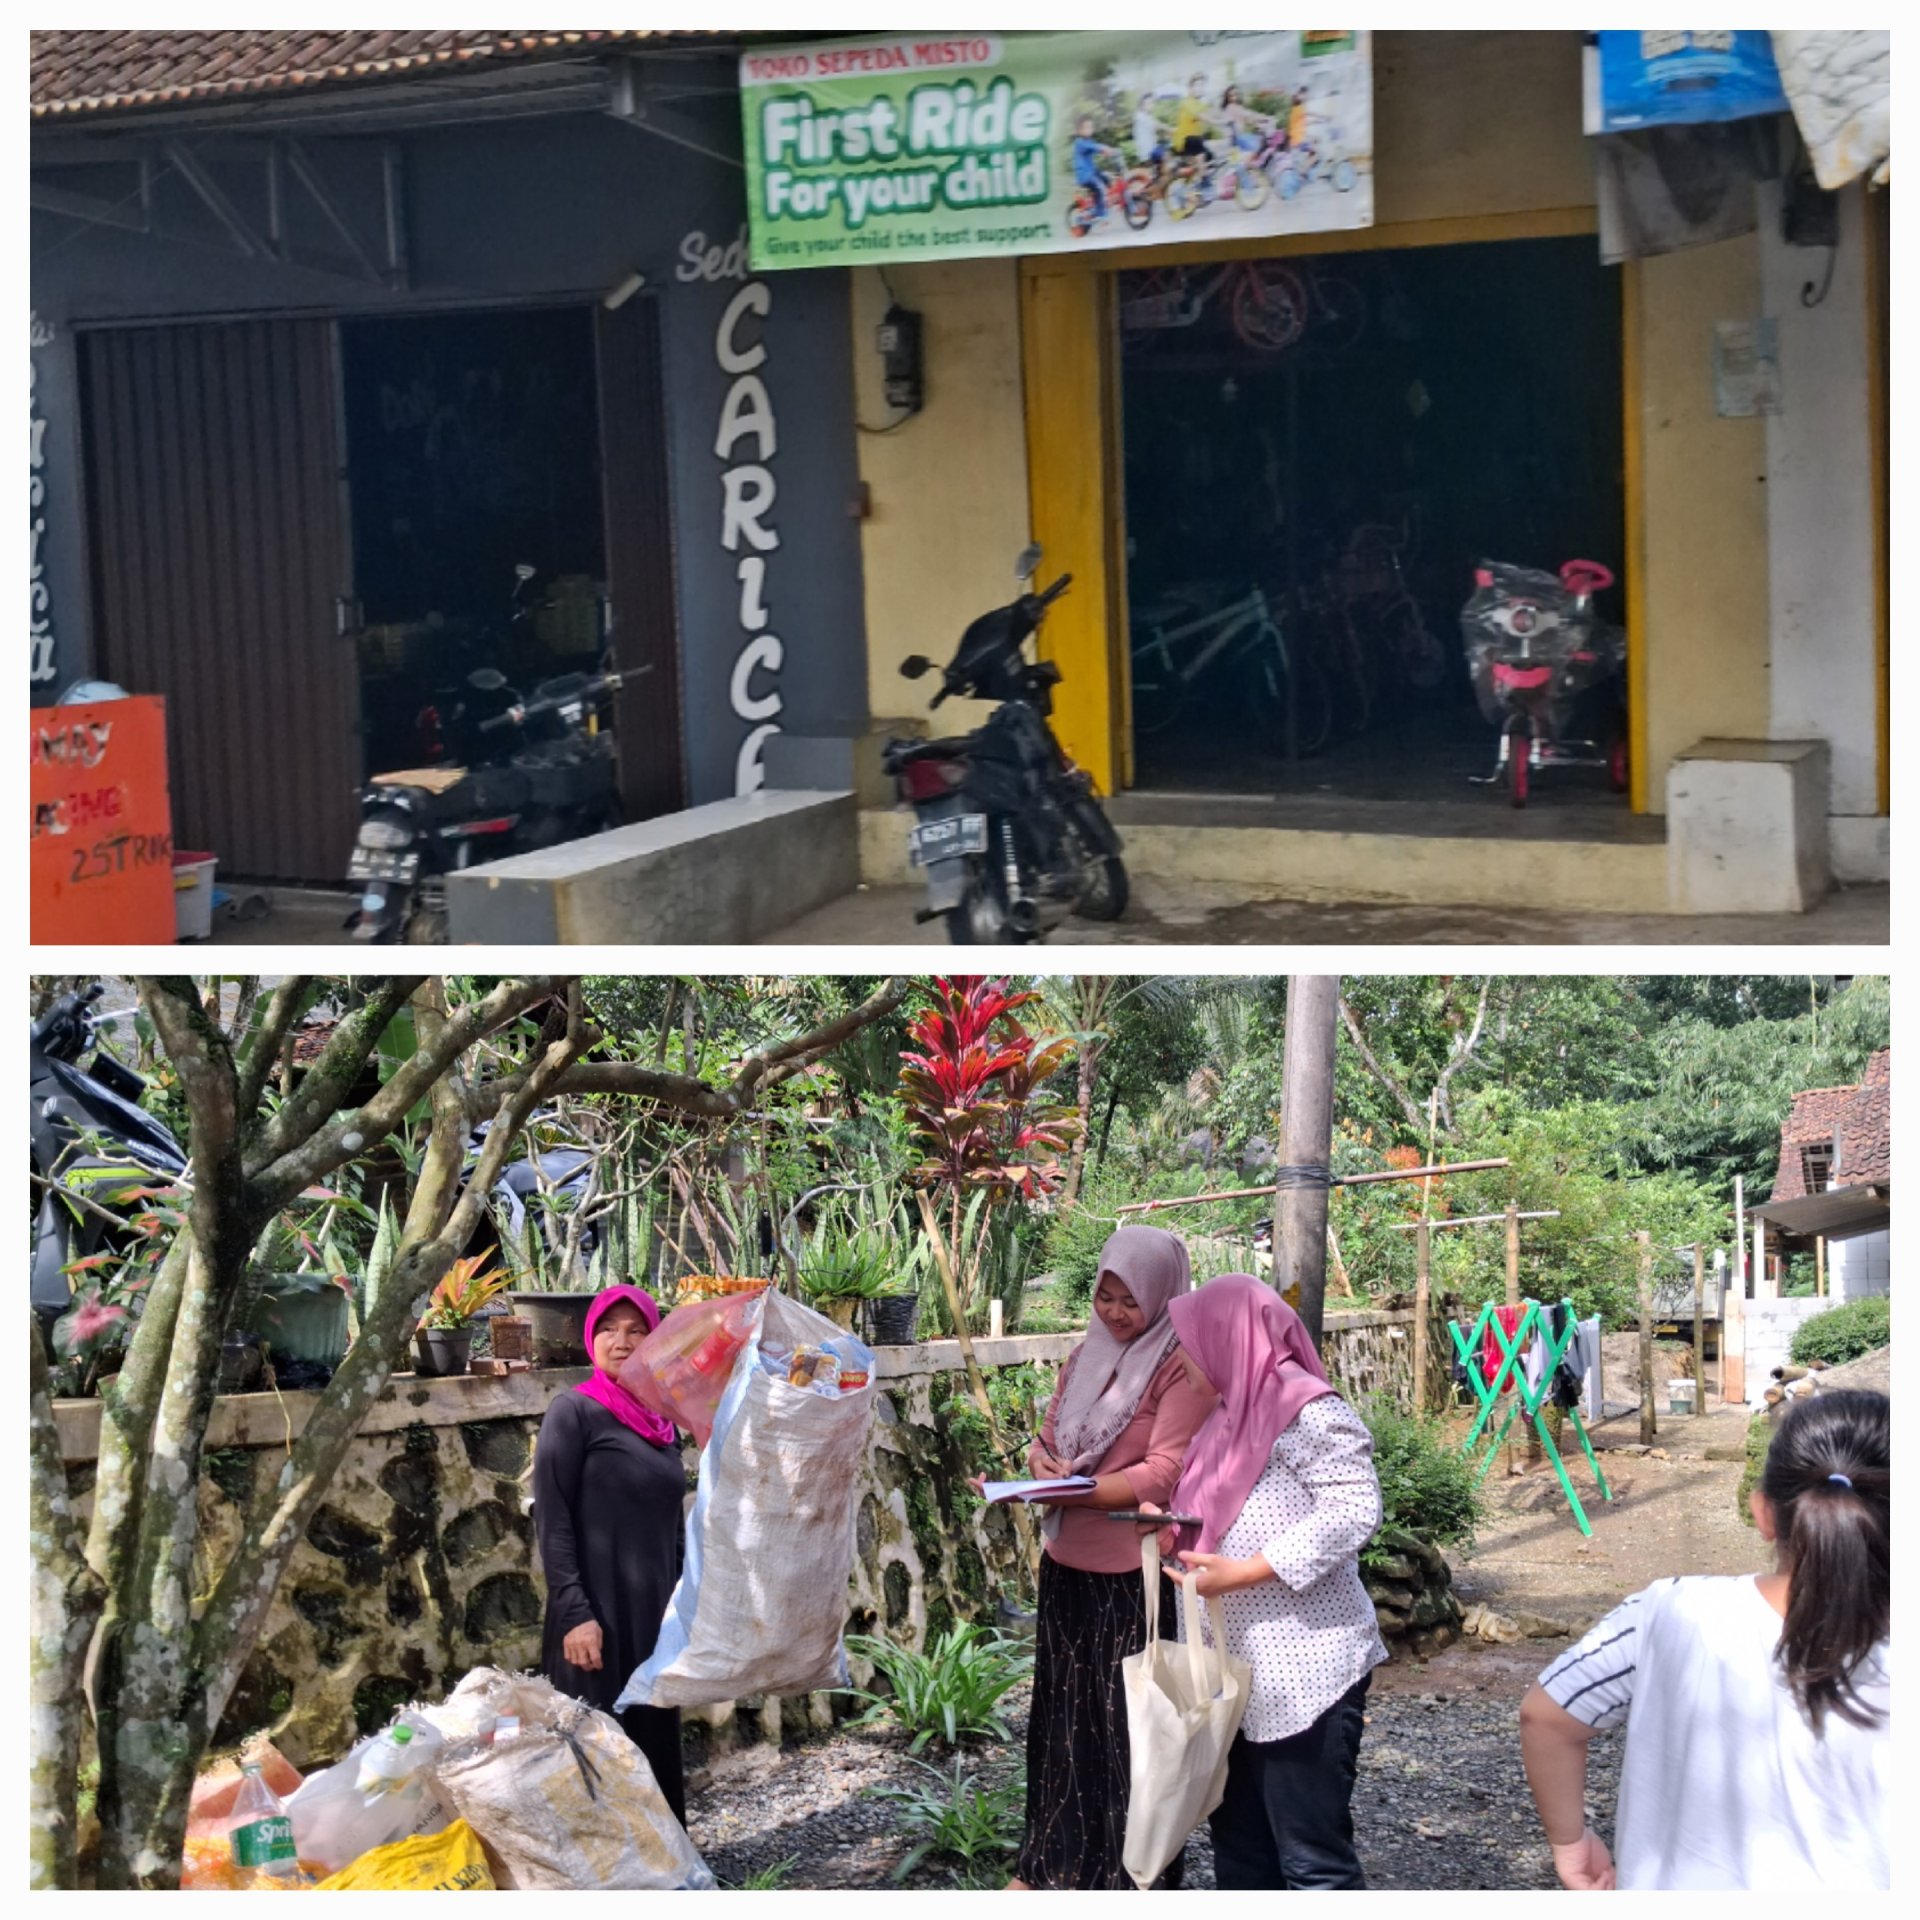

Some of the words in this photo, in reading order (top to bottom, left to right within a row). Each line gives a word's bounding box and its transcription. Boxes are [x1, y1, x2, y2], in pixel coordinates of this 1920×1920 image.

[750, 56, 809, 79] TOKO
[815, 46, 908, 76] SEPEDA
[913, 38, 991, 66] MISTO
[763, 96, 896, 163] First
[910, 83, 1047, 150] Ride
[765, 170, 837, 215] For
[843, 171, 939, 223] your
[944, 148, 1046, 202] child
[675, 221, 748, 281] Sed
[765, 236, 801, 254] Give
[804, 240, 845, 257] your
[850, 230, 892, 250] child
[896, 228, 926, 247] the
[932, 226, 970, 245] best
[976, 223, 1053, 246] support
[126, 1139, 167, 1162] HONDA
[256, 1820, 290, 1844] Spri
